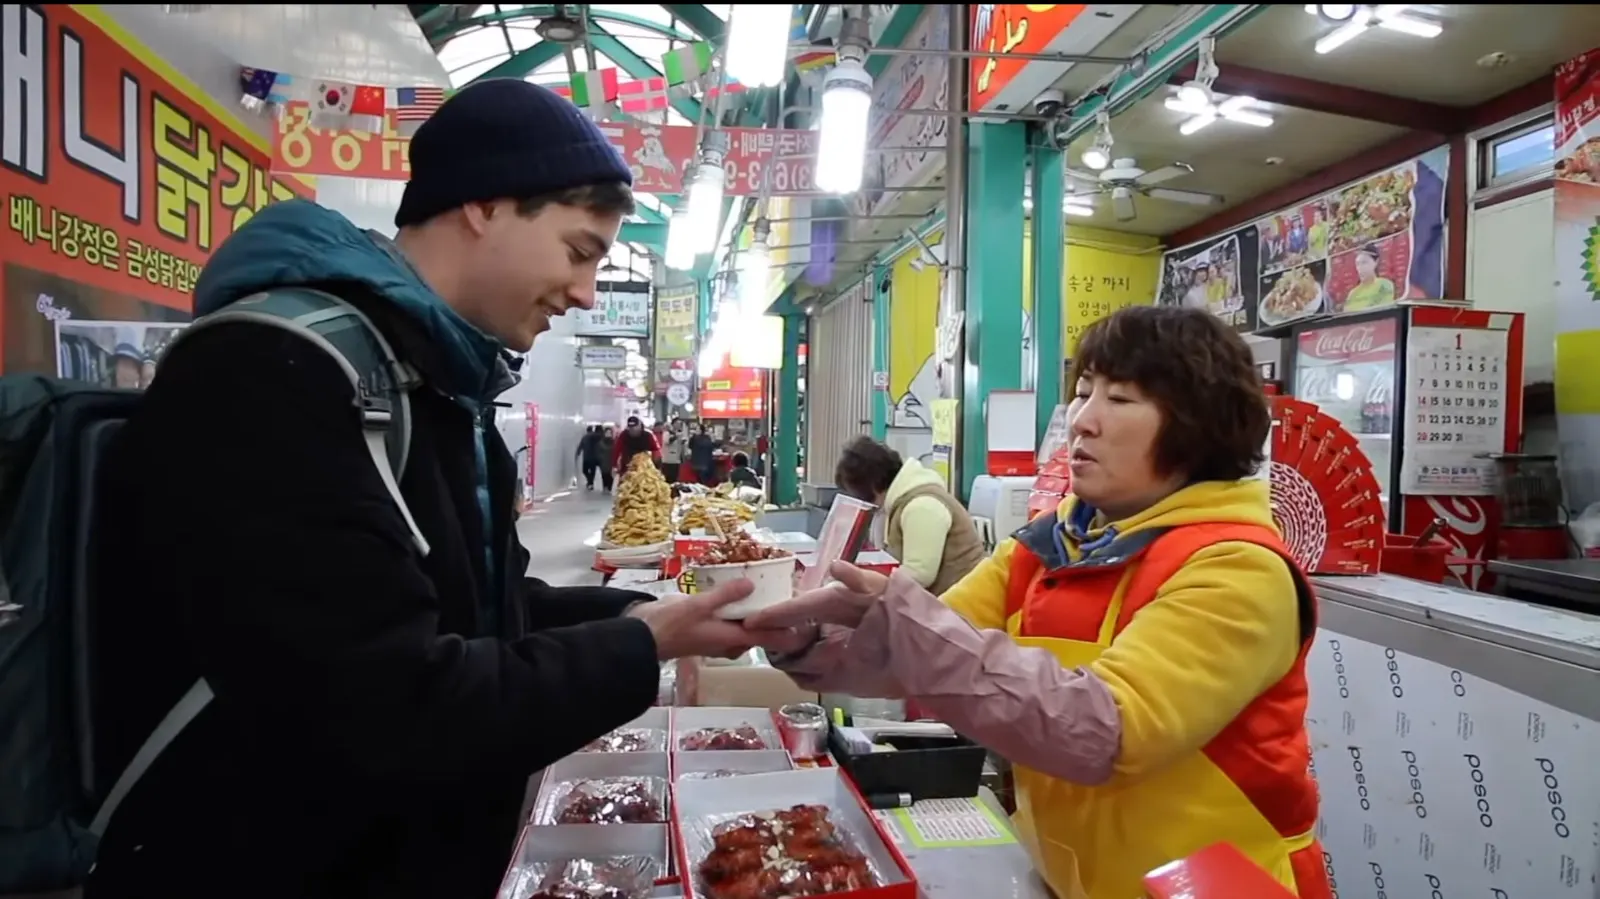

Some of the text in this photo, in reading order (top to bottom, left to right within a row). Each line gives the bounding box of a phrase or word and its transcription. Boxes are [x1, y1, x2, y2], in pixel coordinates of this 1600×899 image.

[151, 92, 297, 250] 닭강
[8, 194, 120, 272] 배니강정은
[1068, 273, 1131, 293] 속살 까지
[1454, 333, 1463, 350] 1
[1419, 378, 1498, 391] 7 8 9 10 11 12 13
[1444, 362, 1450, 371] 2
[1455, 362, 1462, 371] 3
[1467, 363, 1474, 371] 4
[1479, 363, 1486, 373] 5
[1417, 396, 1499, 408] 14 15 16 17 18 19 20
[1417, 415, 1498, 426] 21 22 23 24 25 26 27
[1417, 432, 1463, 442] 28 29 30 31
[1328, 639, 1349, 699] posco
[1384, 647, 1404, 699] osco
[1348, 745, 1370, 812] posco
[1401, 749, 1428, 820] posco
[1463, 752, 1493, 829] posco
[1535, 756, 1570, 839] posco
[1368, 861, 1388, 899] pos
